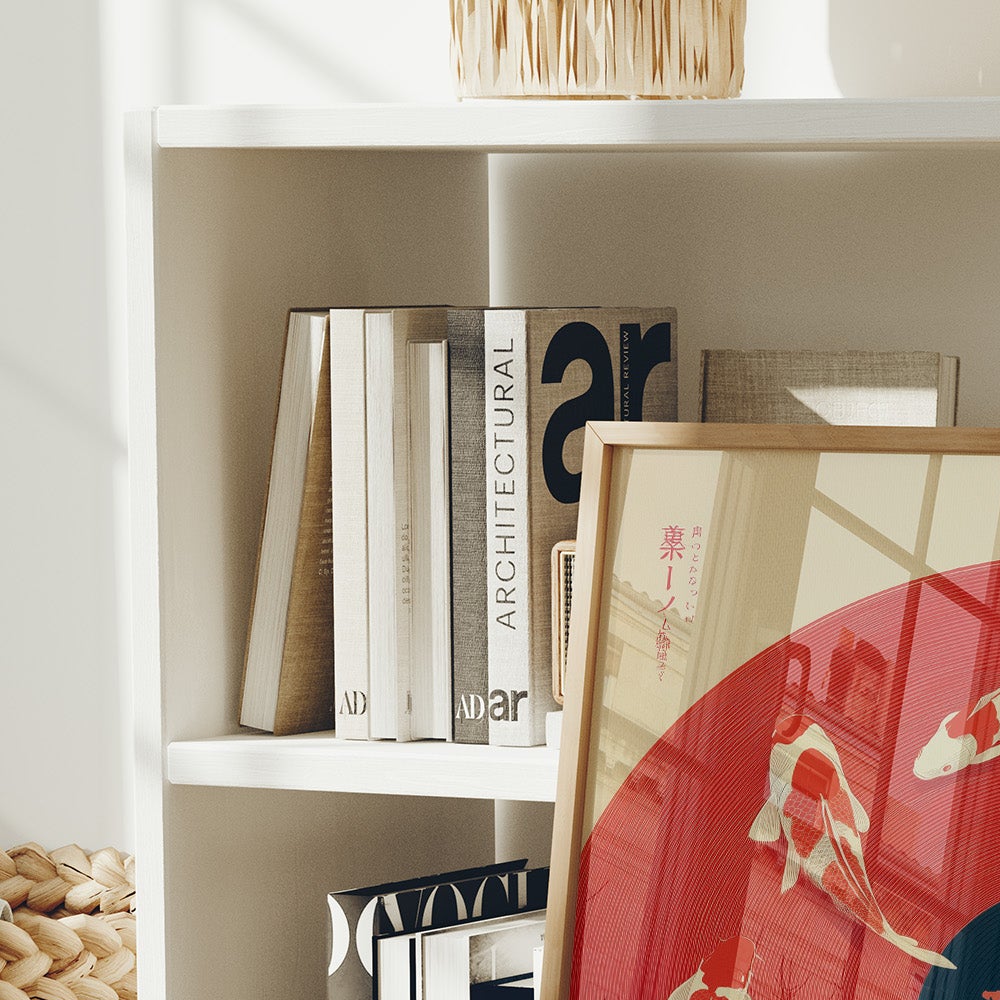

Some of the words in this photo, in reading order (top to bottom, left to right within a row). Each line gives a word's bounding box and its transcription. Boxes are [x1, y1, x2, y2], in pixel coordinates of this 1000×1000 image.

[622, 330, 630, 378] REVIEW
[541, 321, 671, 504] ar
[493, 338, 517, 629] ARCHITECTURAL
[339, 690, 368, 715] AD
[455, 694, 486, 721] AD
[489, 689, 528, 722] ar
